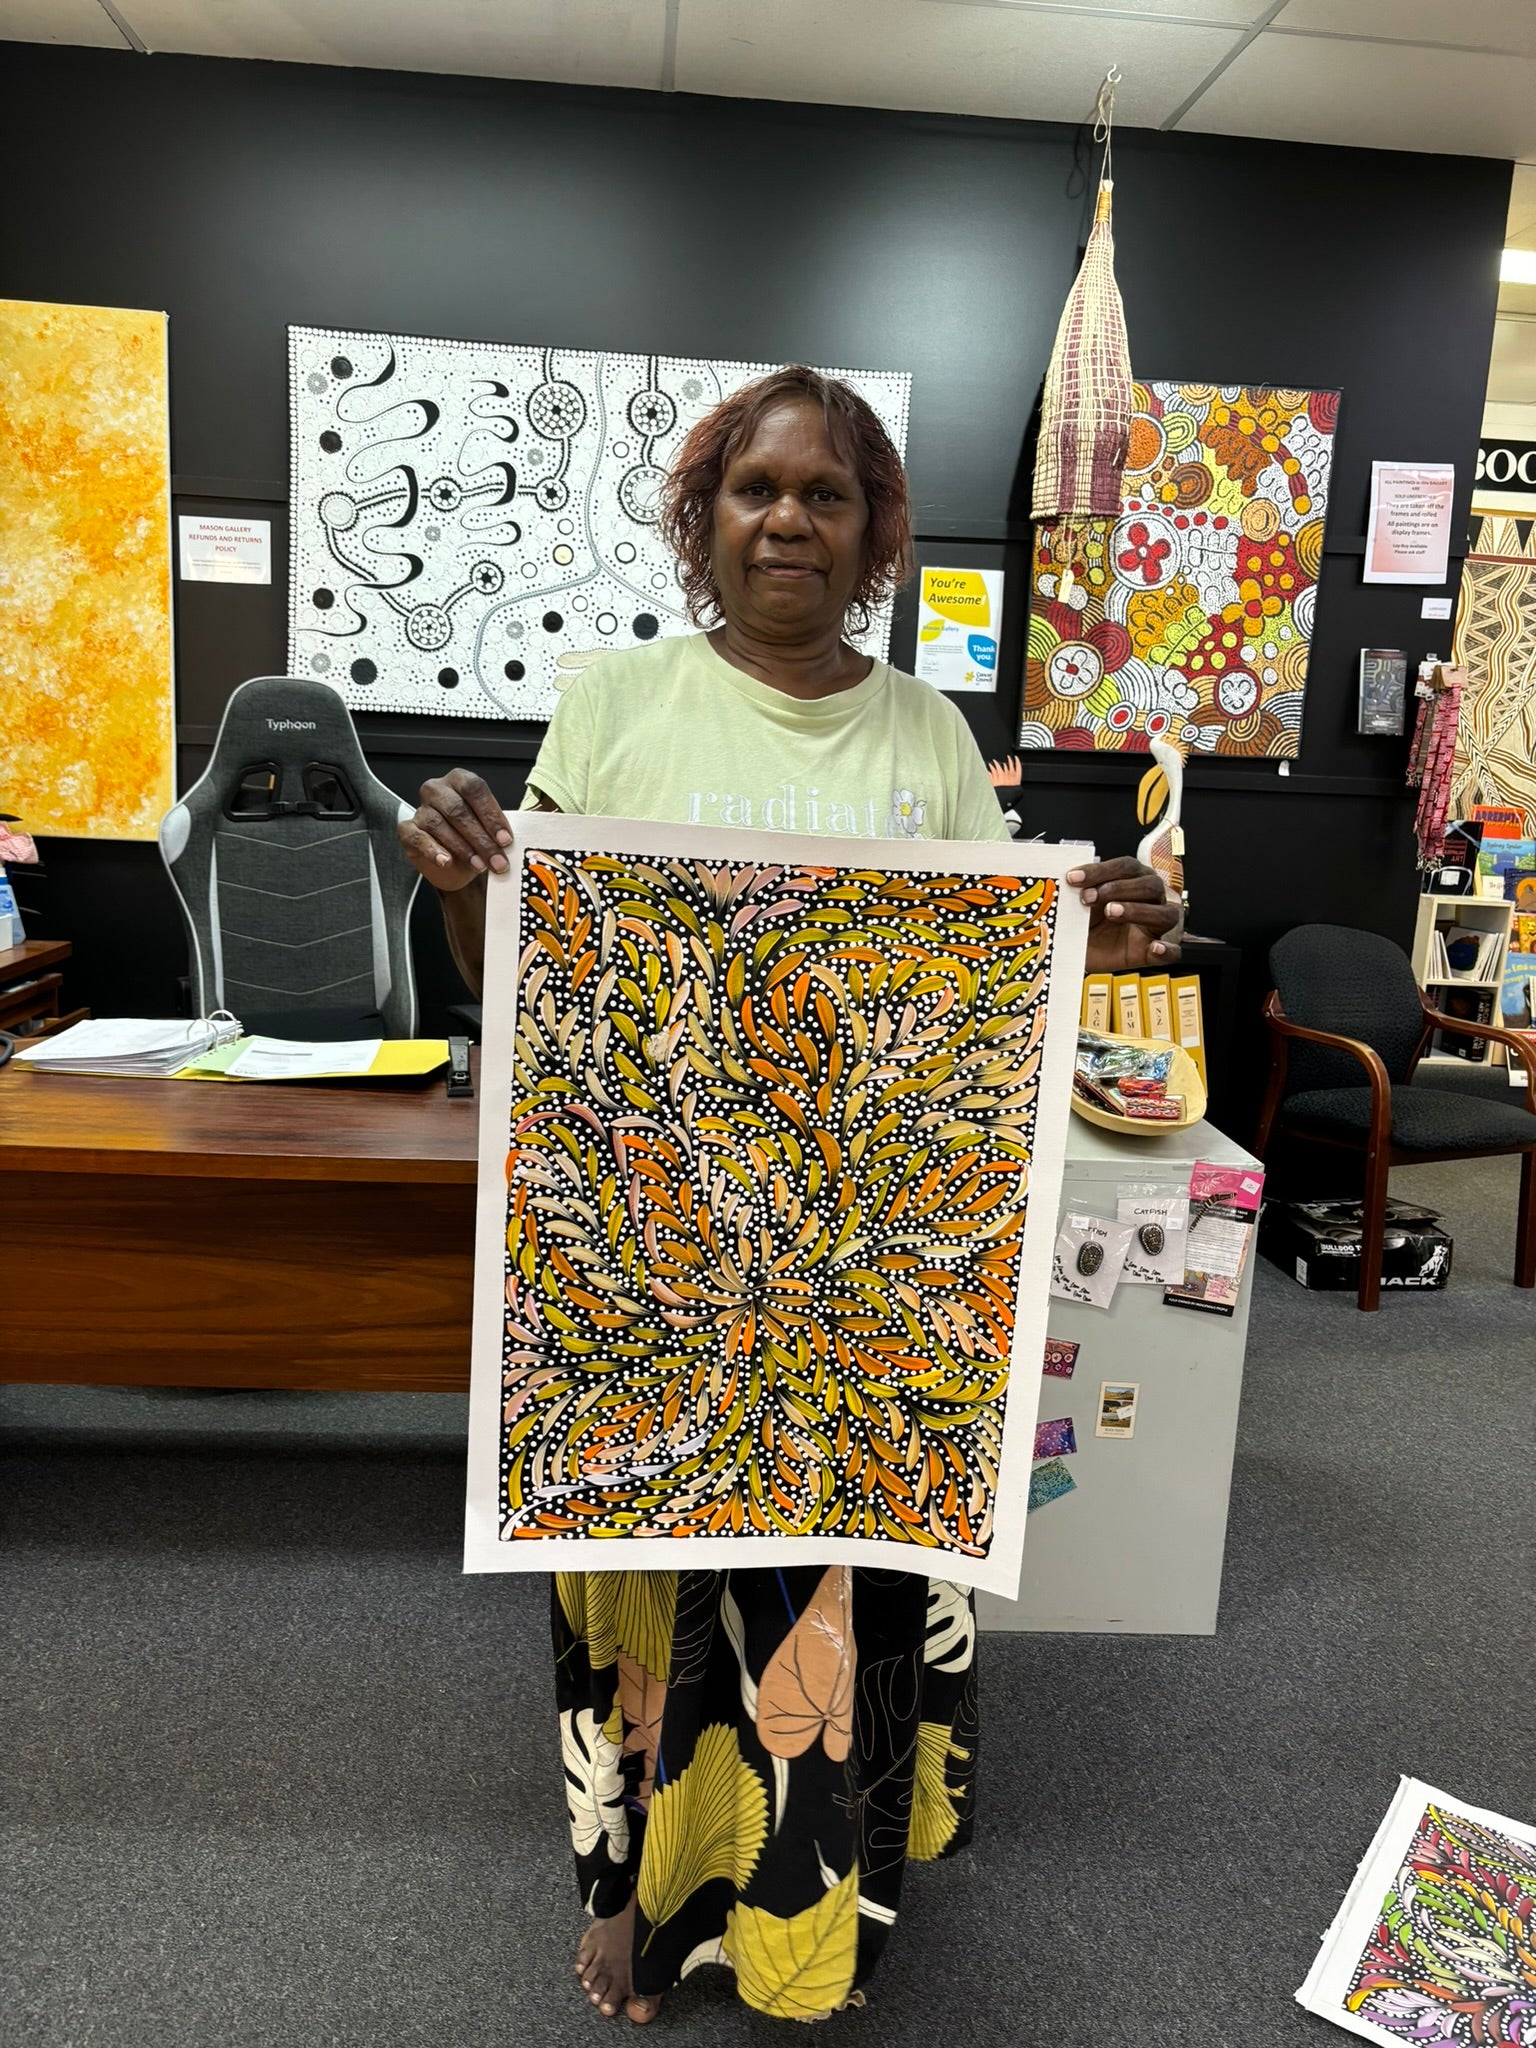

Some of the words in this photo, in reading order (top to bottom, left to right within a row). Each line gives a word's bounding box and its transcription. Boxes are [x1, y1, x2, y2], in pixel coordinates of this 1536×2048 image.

[266, 718, 316, 731] Typhoon
[1134, 1208, 1167, 1216] CATFISH
[1081, 1227, 1108, 1237] TFISH
